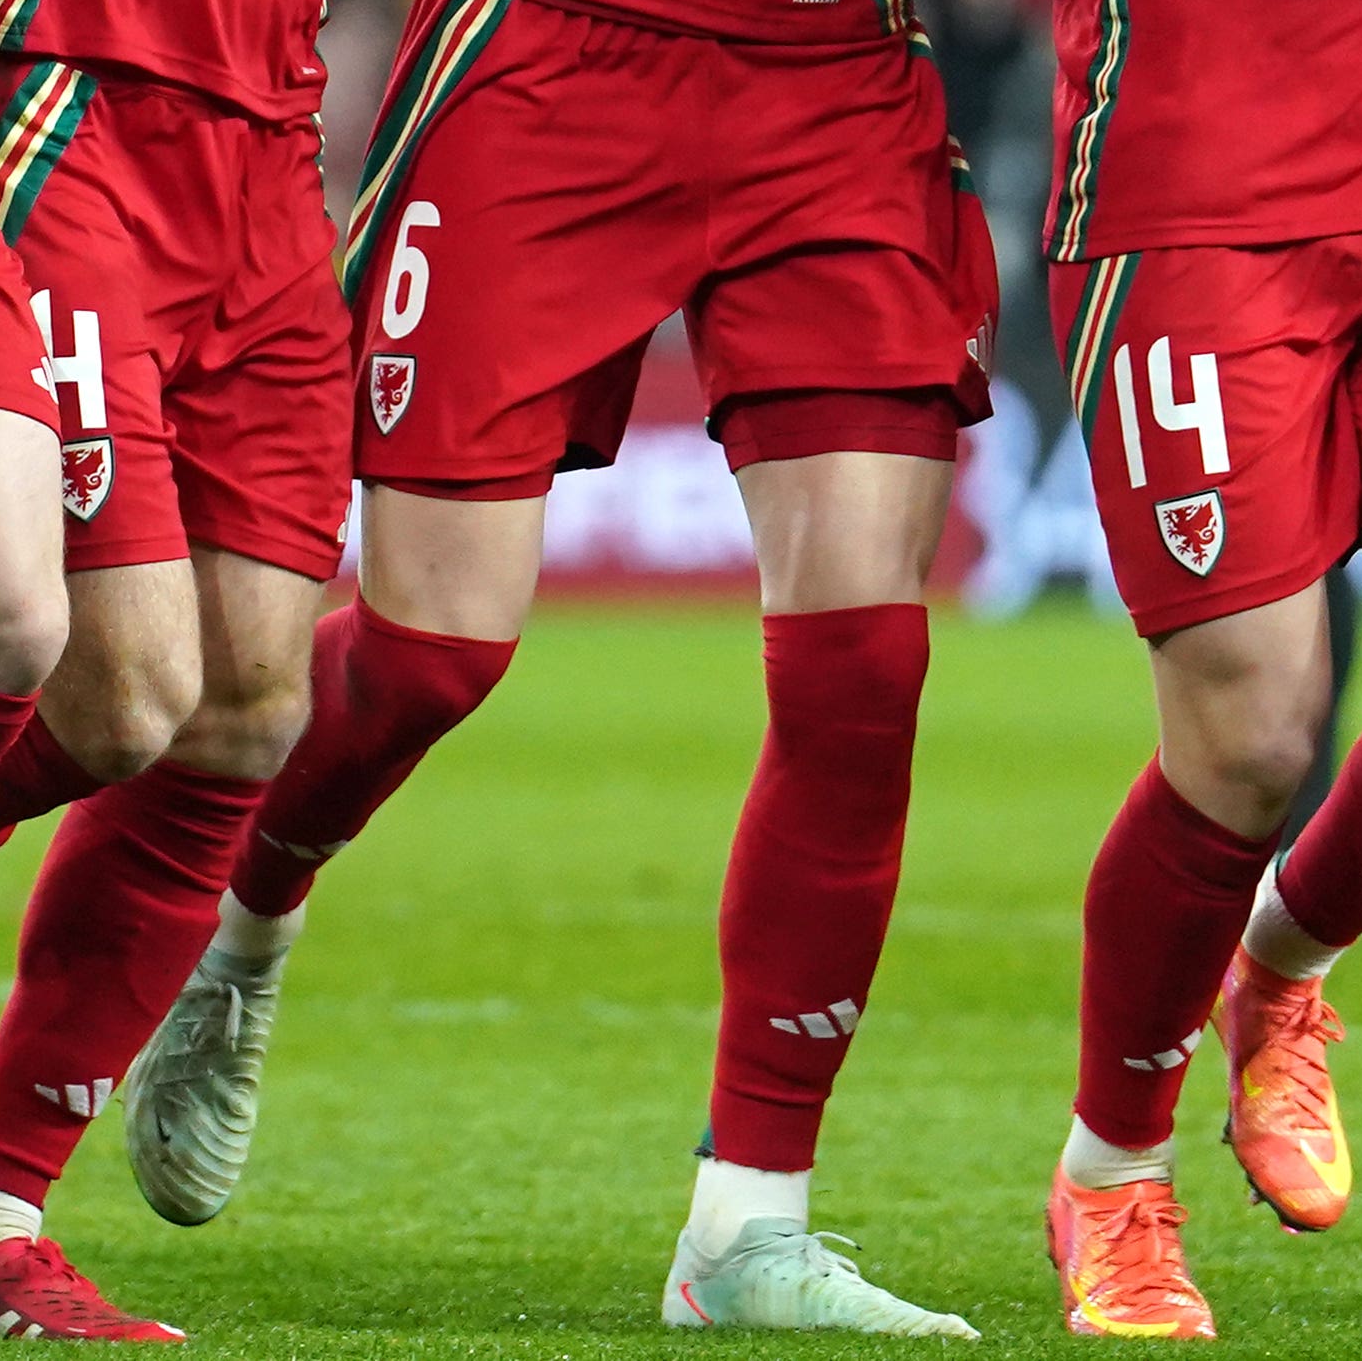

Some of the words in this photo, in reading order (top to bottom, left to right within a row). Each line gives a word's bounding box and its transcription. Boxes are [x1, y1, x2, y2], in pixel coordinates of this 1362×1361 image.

[382, 201, 440, 339] 6
[28, 289, 107, 428] 4
[1114, 336, 1230, 488] 14
